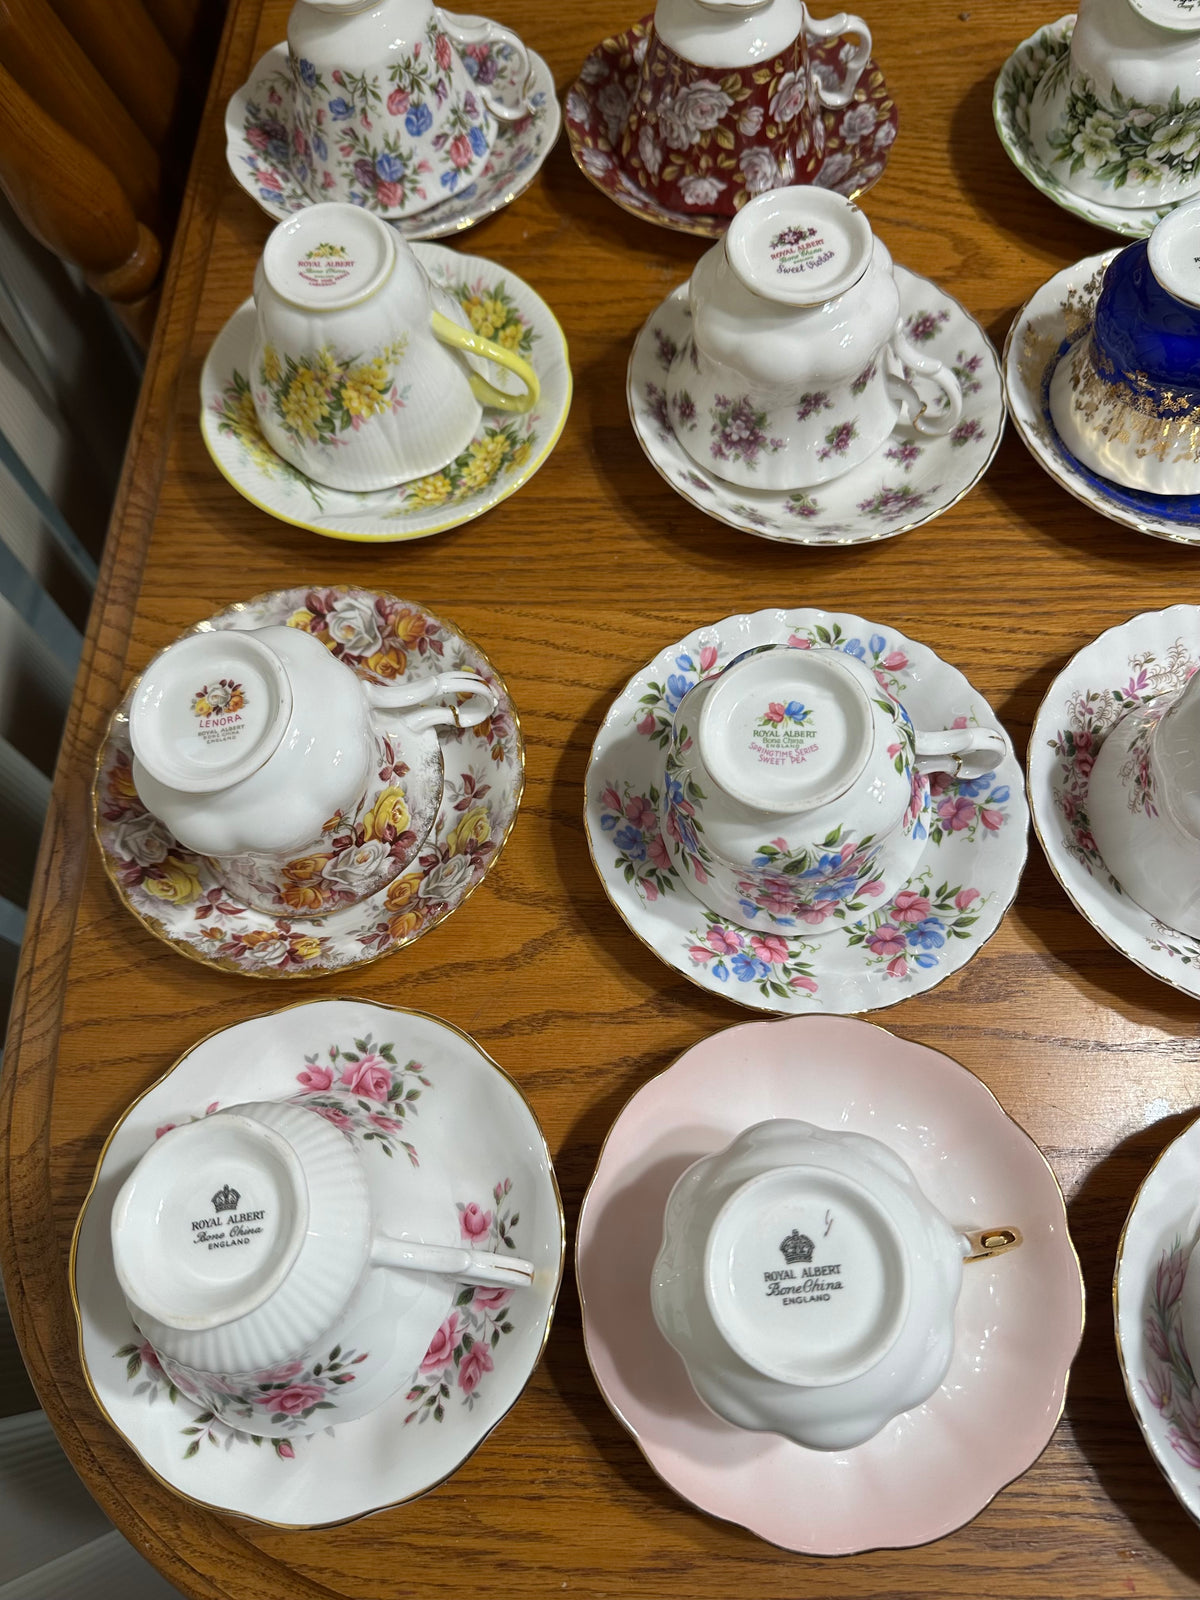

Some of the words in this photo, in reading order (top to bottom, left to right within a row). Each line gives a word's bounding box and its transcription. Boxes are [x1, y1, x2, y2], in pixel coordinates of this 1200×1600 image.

[770, 248, 796, 260] ROYAL
[797, 239, 824, 252] ALBERT
[776, 263, 806, 274] Sweet
[199, 714, 242, 728] LENORA
[197, 729, 218, 737] ROYAL
[220, 724, 245, 733] ALBERT
[753, 730, 780, 738] ROYAL
[783, 730, 817, 738] ALBERT
[782, 737, 804, 745] China
[758, 753, 786, 766] SWEET
[789, 755, 807, 765] PEA
[191, 1216, 223, 1231] ROYAL
[226, 1210, 266, 1225] ALBERT
[193, 1230, 226, 1244] Bone
[229, 1224, 264, 1238] China
[208, 1237, 251, 1250] ENGLAND
[763, 1269, 797, 1282] ROYAL
[801, 1264, 842, 1279] ALBERT
[766, 1282, 803, 1296] Bone
[802, 1278, 844, 1294] China
[782, 1293, 831, 1306] ENGLAND
